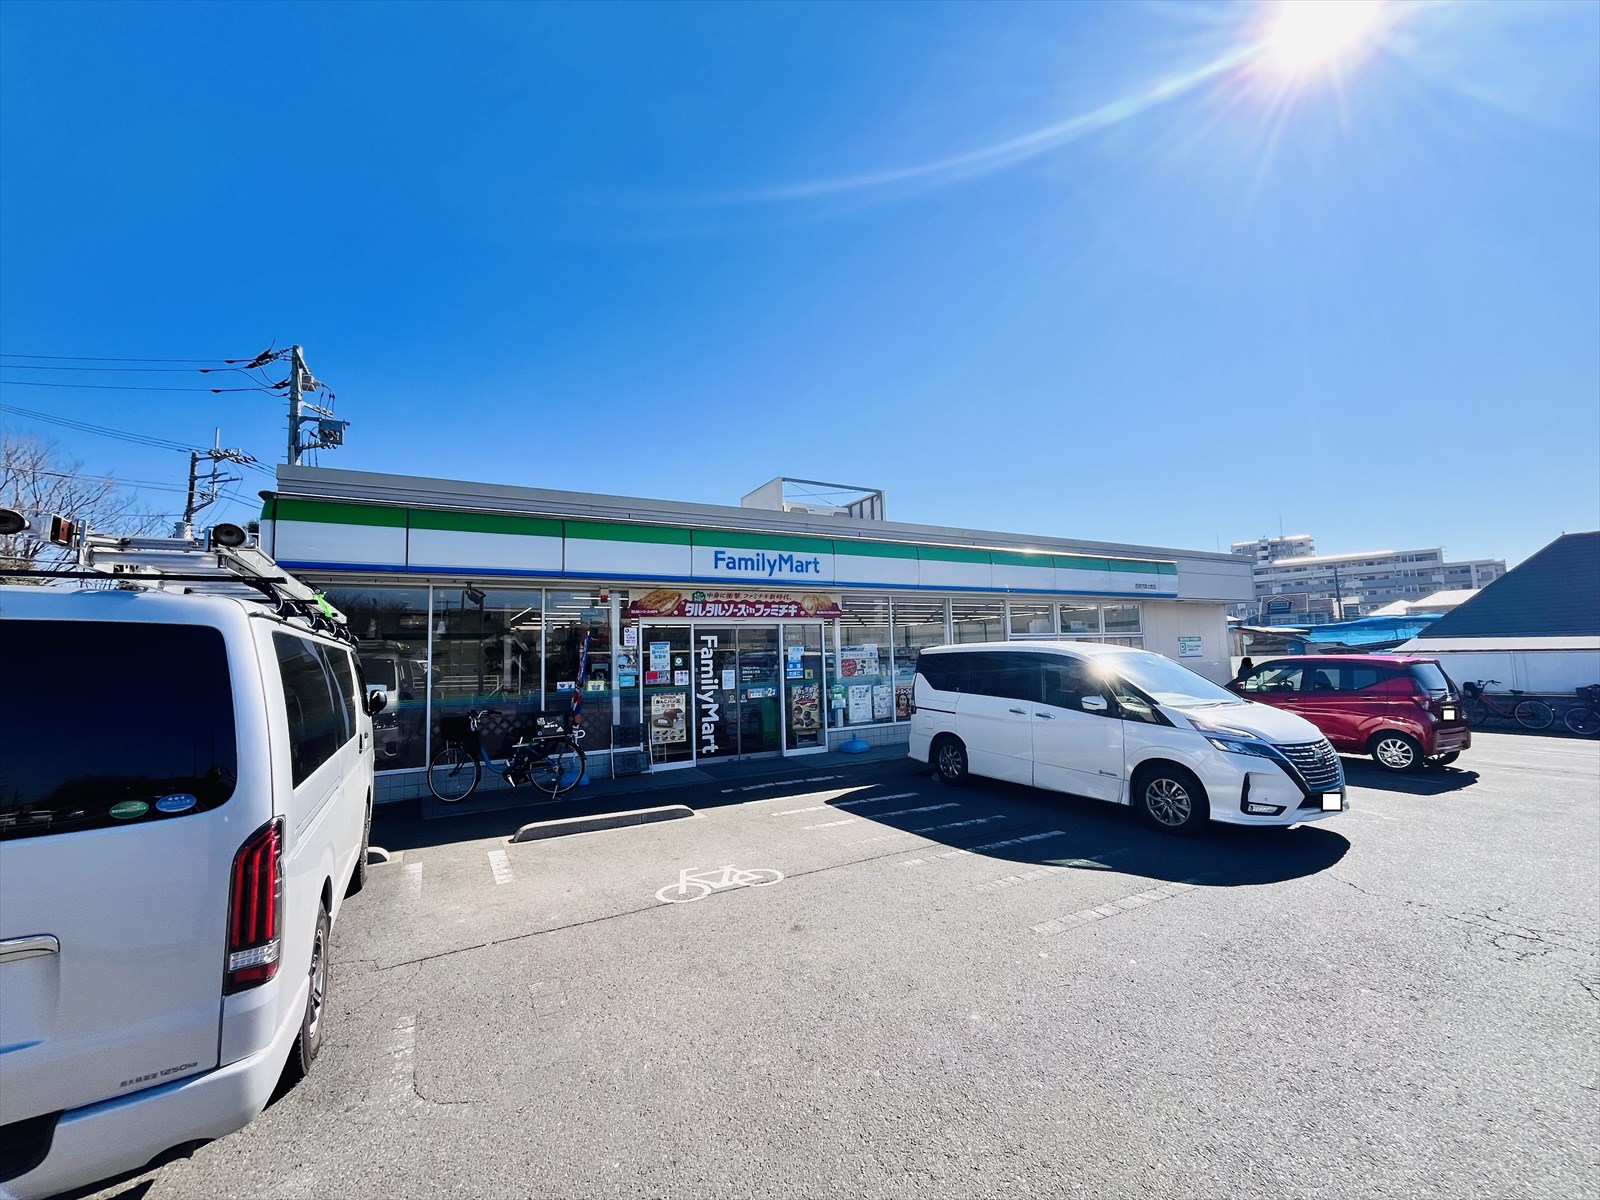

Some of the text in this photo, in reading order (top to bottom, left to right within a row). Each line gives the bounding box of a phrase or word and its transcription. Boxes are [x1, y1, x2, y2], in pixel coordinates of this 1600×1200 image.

[714, 551, 820, 577] FamilyMart
[685, 602, 798, 617] タルタルソースinファミチキ
[697, 635, 720, 754] FamilyMart
